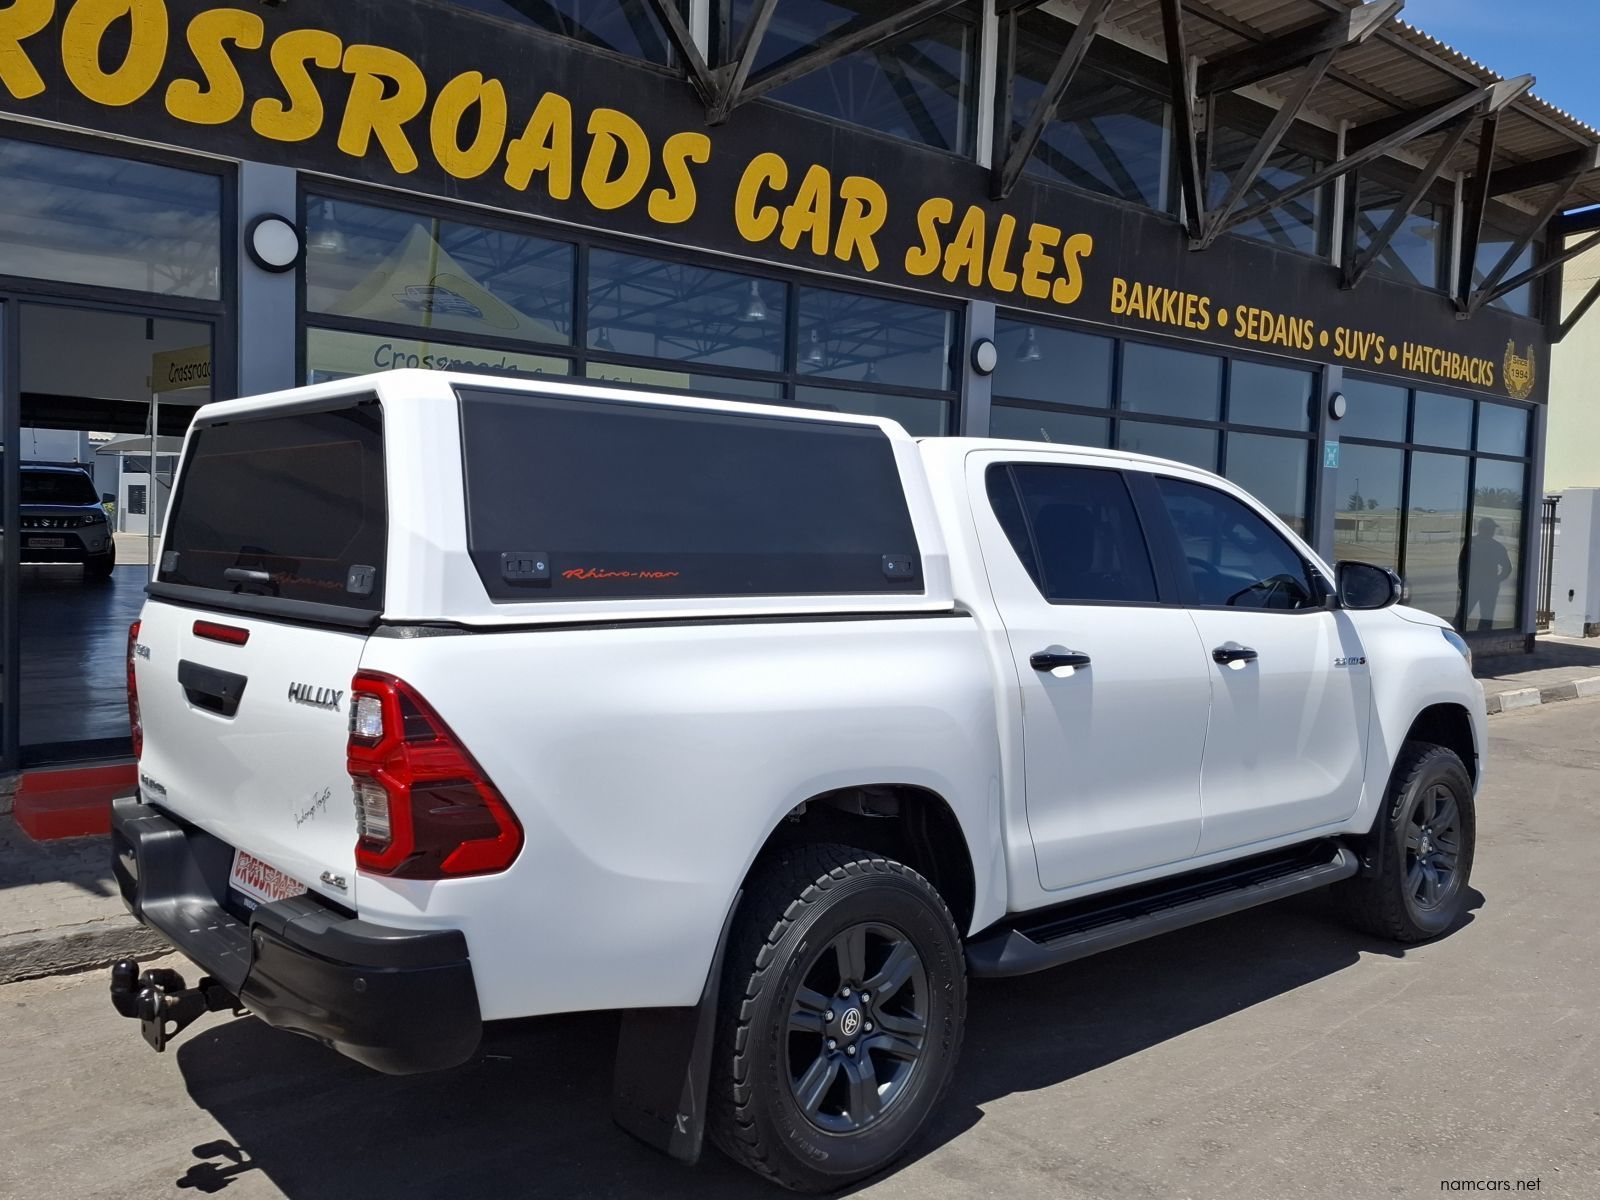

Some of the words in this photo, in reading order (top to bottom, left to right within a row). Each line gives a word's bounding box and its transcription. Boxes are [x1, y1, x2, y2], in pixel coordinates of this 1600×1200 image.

[734, 152, 888, 273] CAR
[904, 197, 1094, 305] SALES
[1110, 277, 1210, 331] BAKKIES
[1234, 305, 1314, 352] SEDANS
[1333, 326, 1385, 364] SUV'S
[1401, 342, 1494, 388] HATCHBACKS
[1511, 368, 1528, 380] 1994
[288, 681, 344, 708] HILUX
